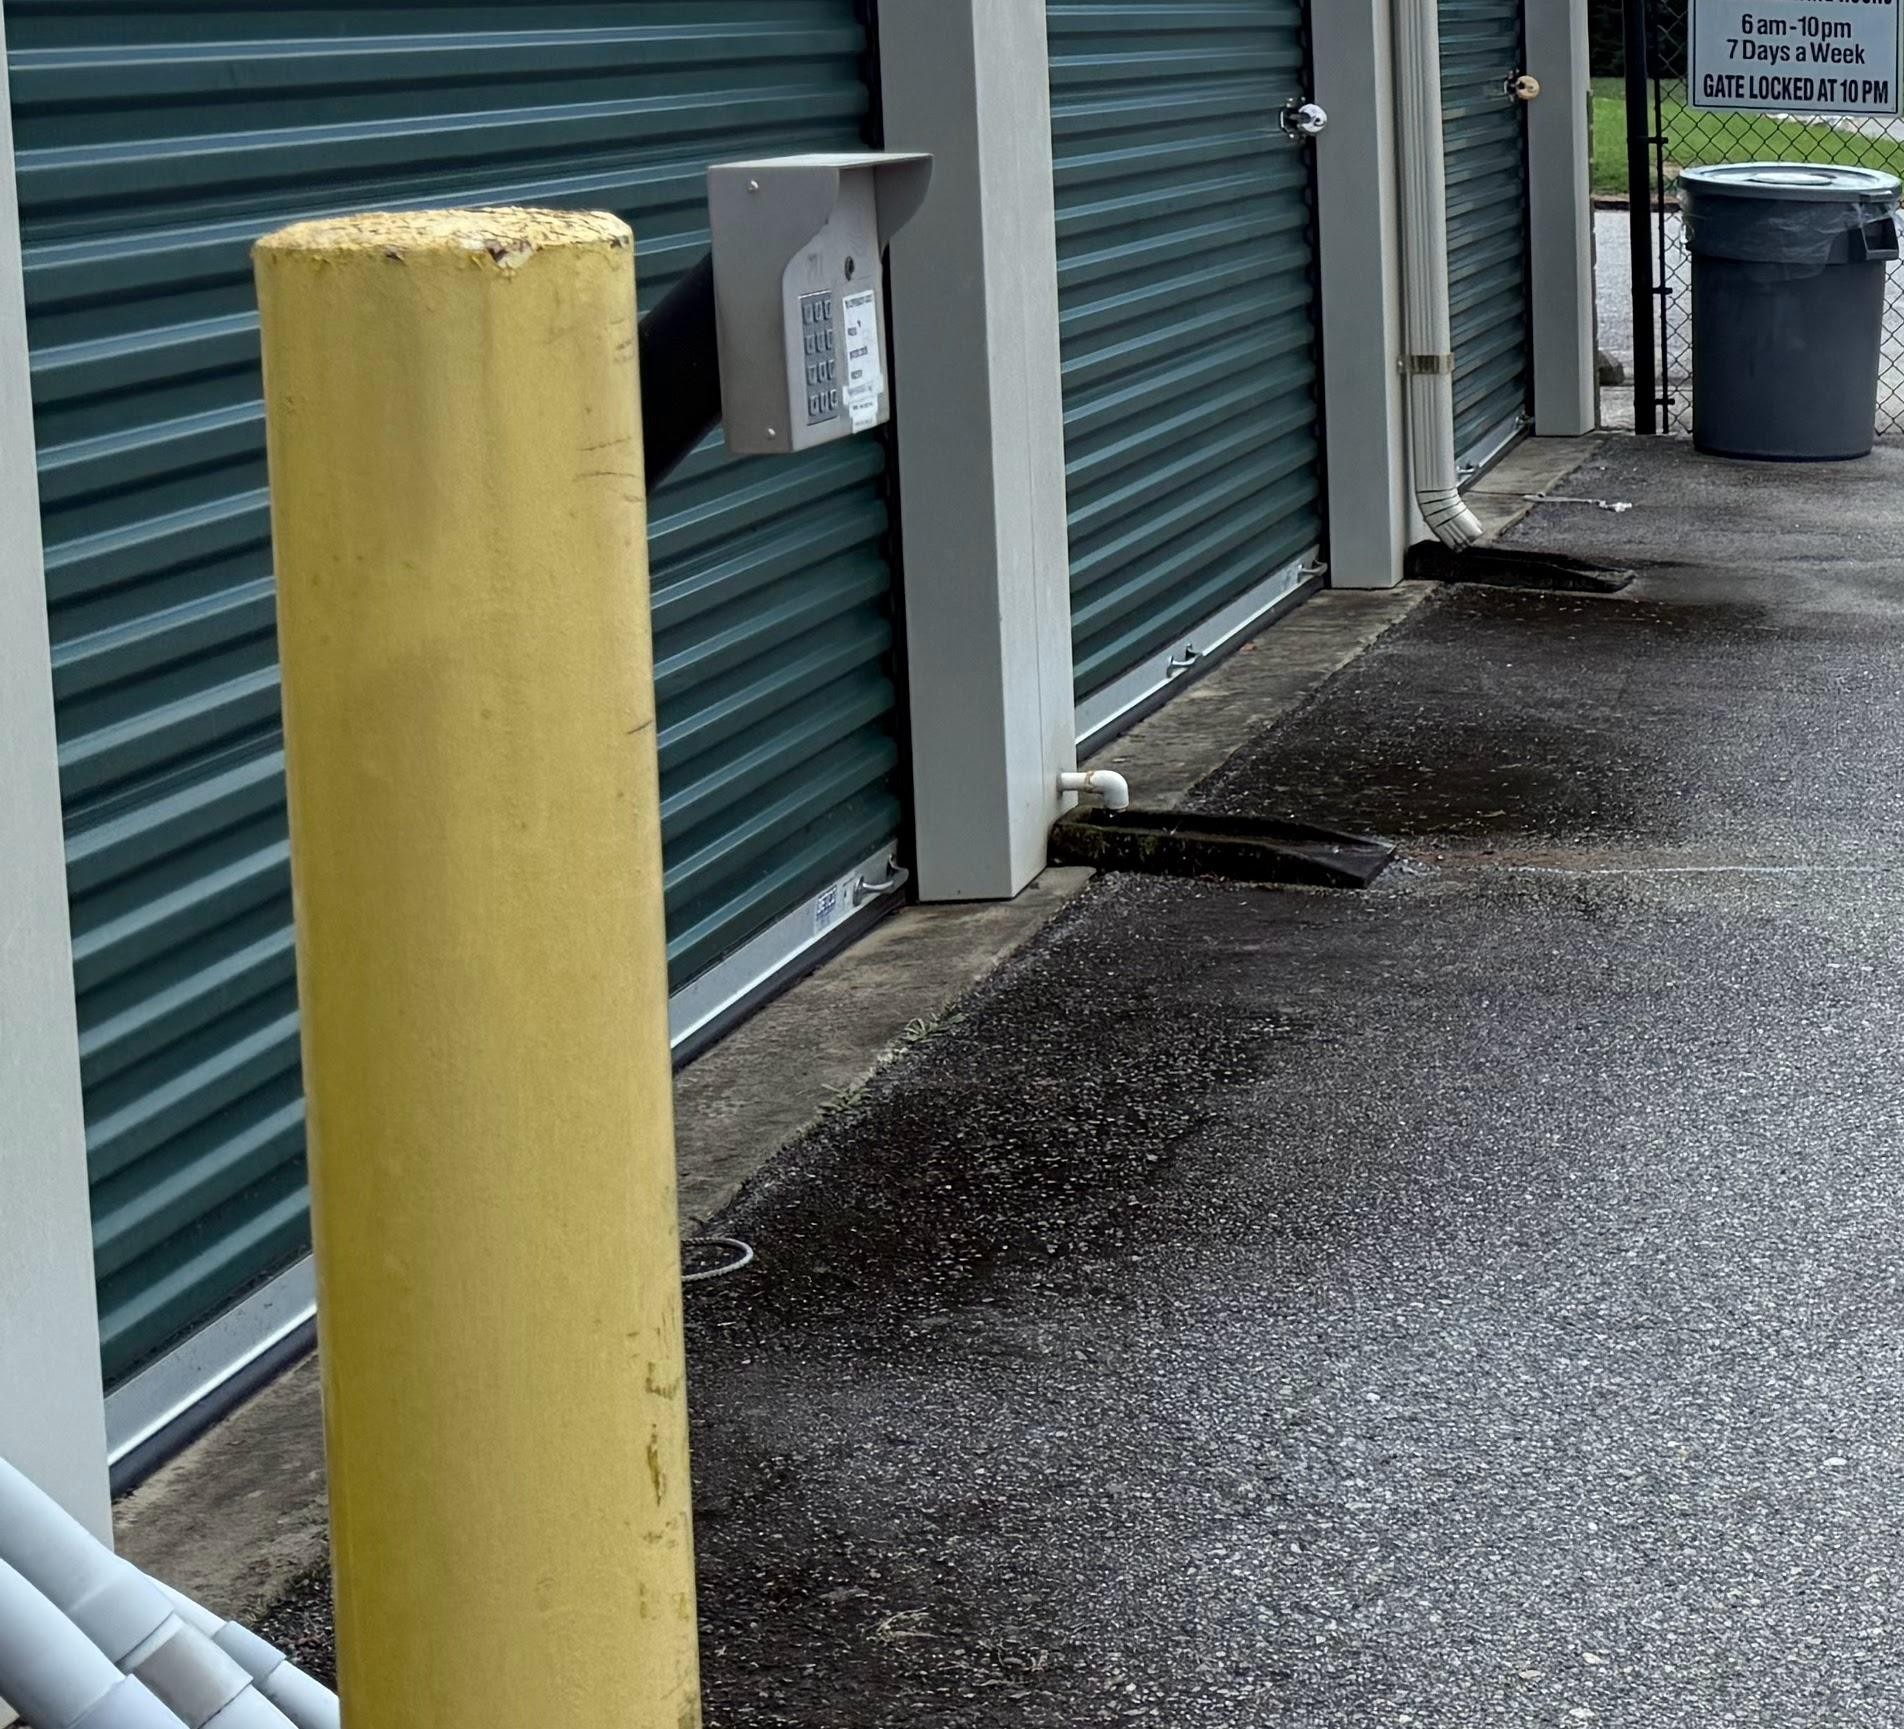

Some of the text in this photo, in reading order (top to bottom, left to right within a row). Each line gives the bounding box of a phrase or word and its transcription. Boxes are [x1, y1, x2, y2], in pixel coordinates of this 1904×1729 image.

[1726, 38, 1866, 66] 7 Days a Week
[1703, 73, 1889, 104] GATE LOCKED AT 10 PM
